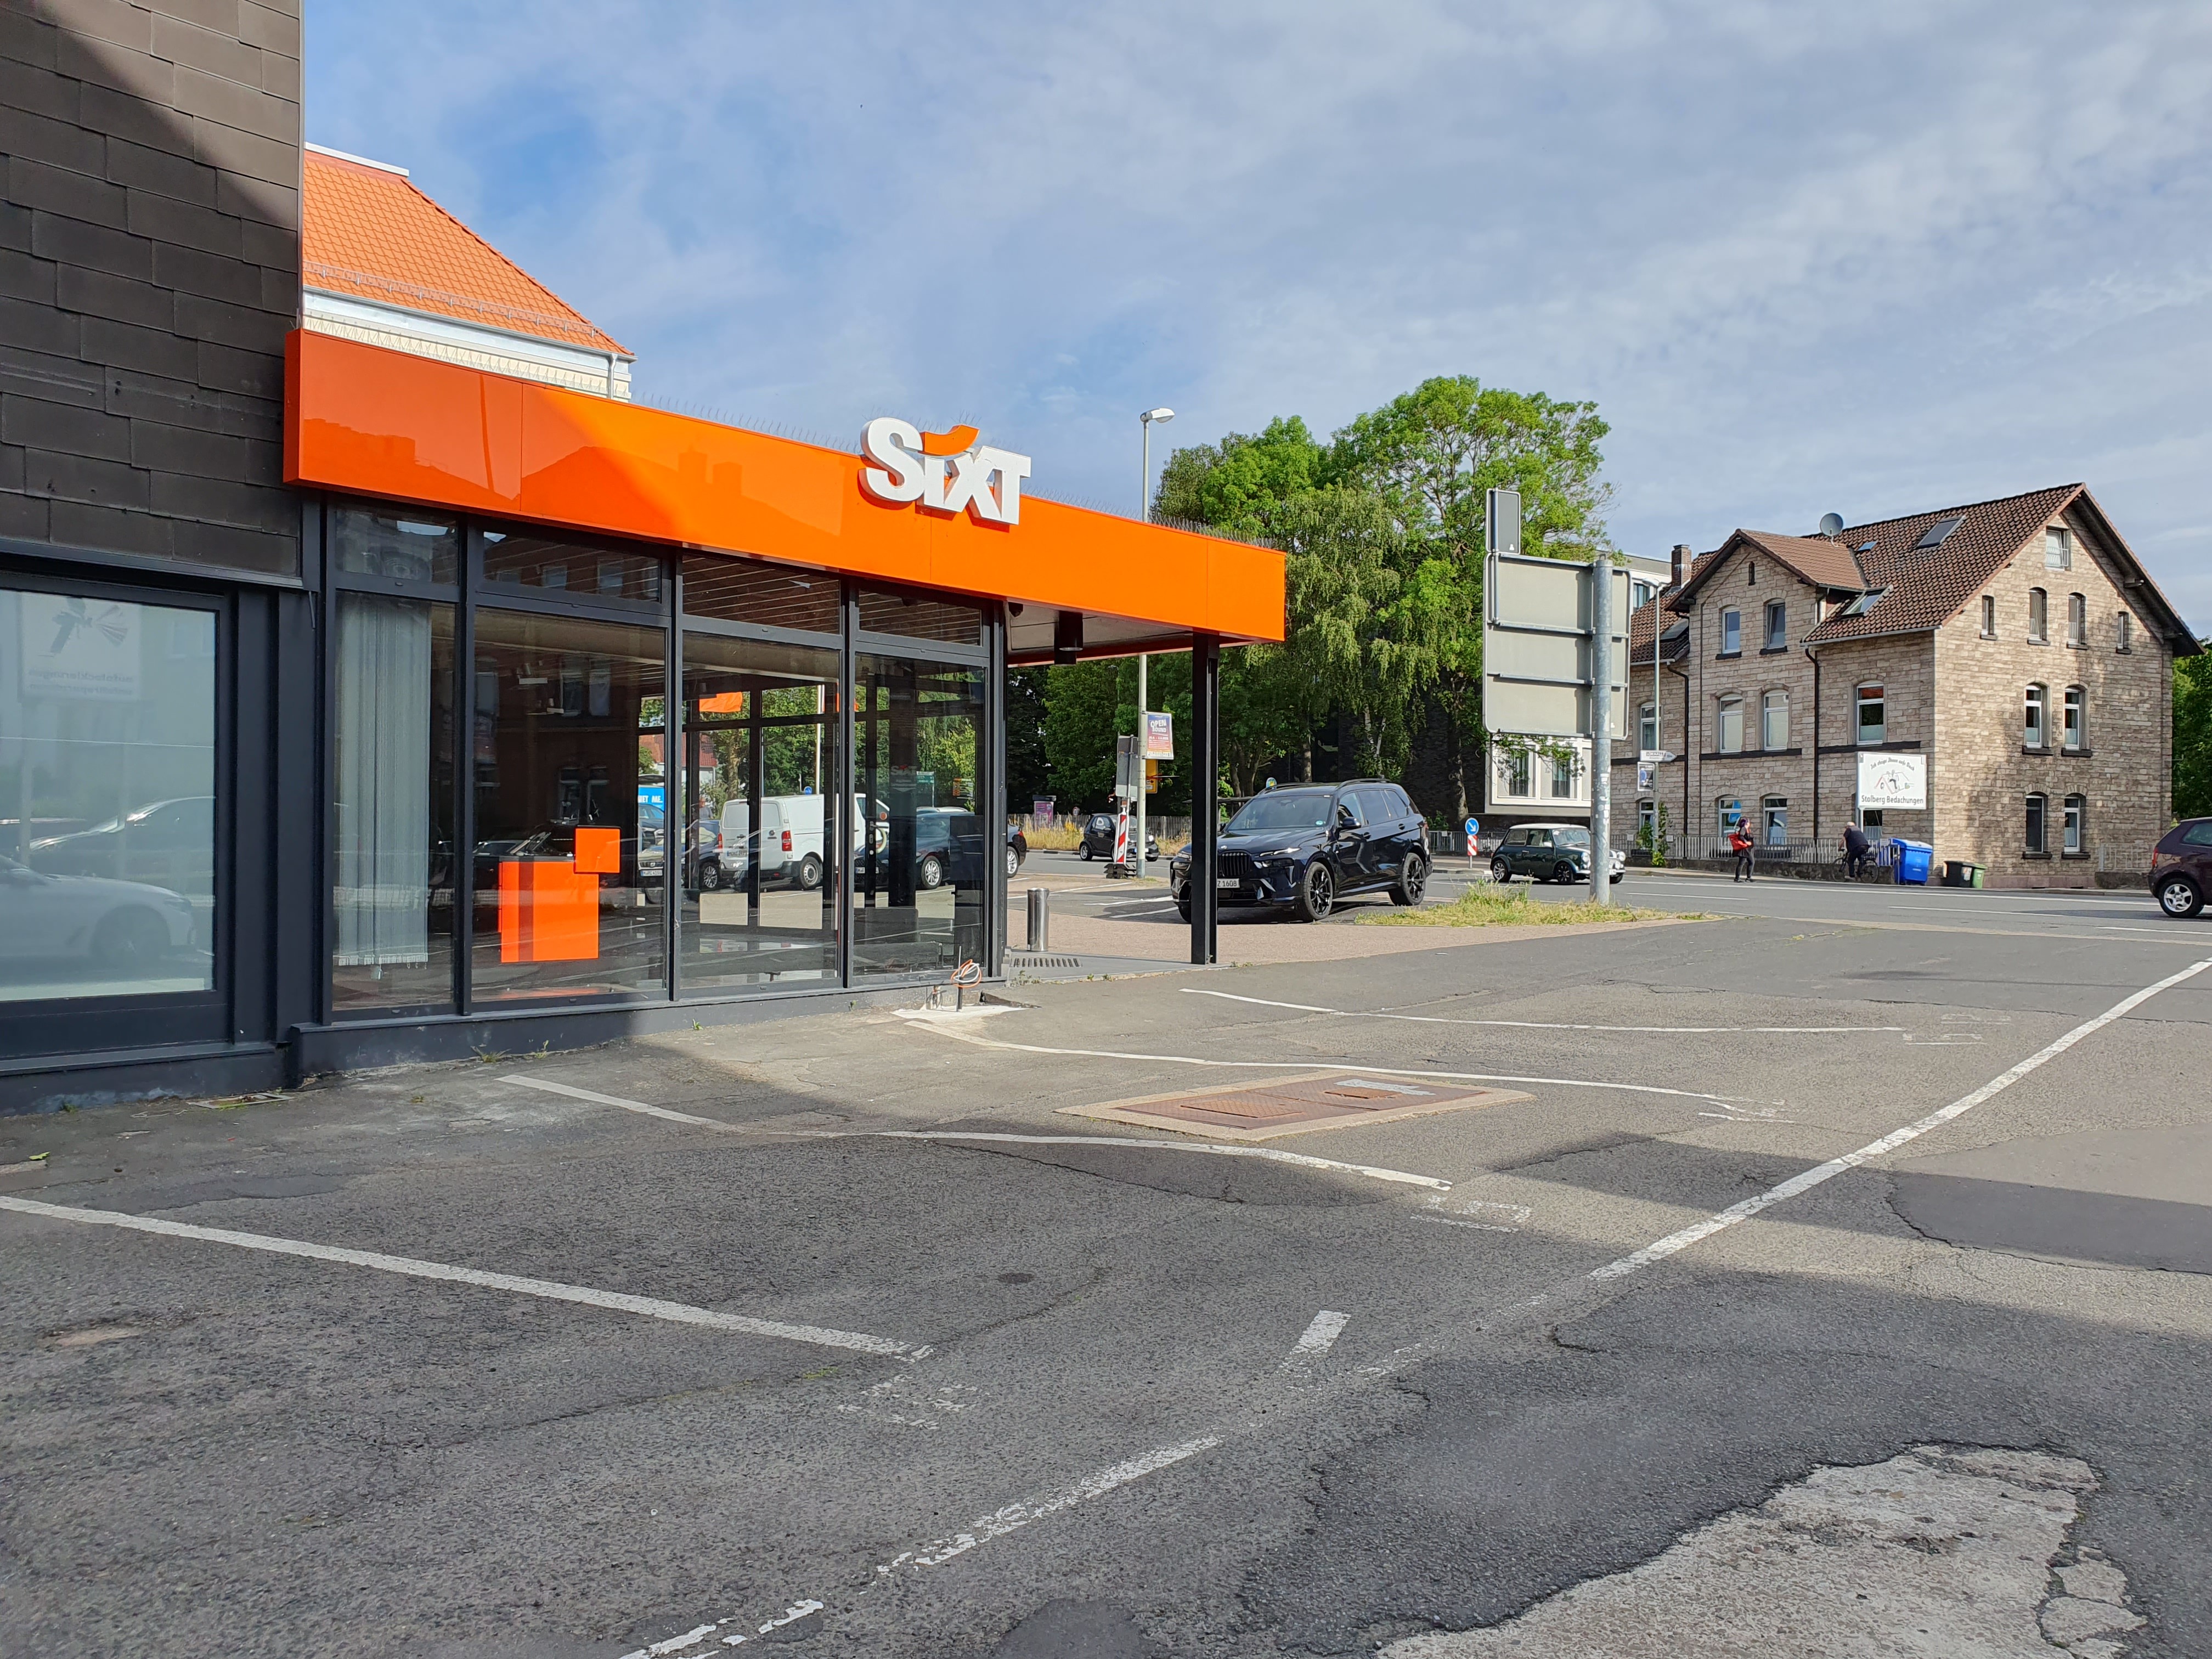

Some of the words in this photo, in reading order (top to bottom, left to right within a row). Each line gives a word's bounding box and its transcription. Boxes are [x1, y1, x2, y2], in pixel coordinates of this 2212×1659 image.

[1150, 719, 1166, 727] OPEN
[1861, 795, 1885, 805] Stolberg
[1887, 795, 1923, 805] Bedachungen
